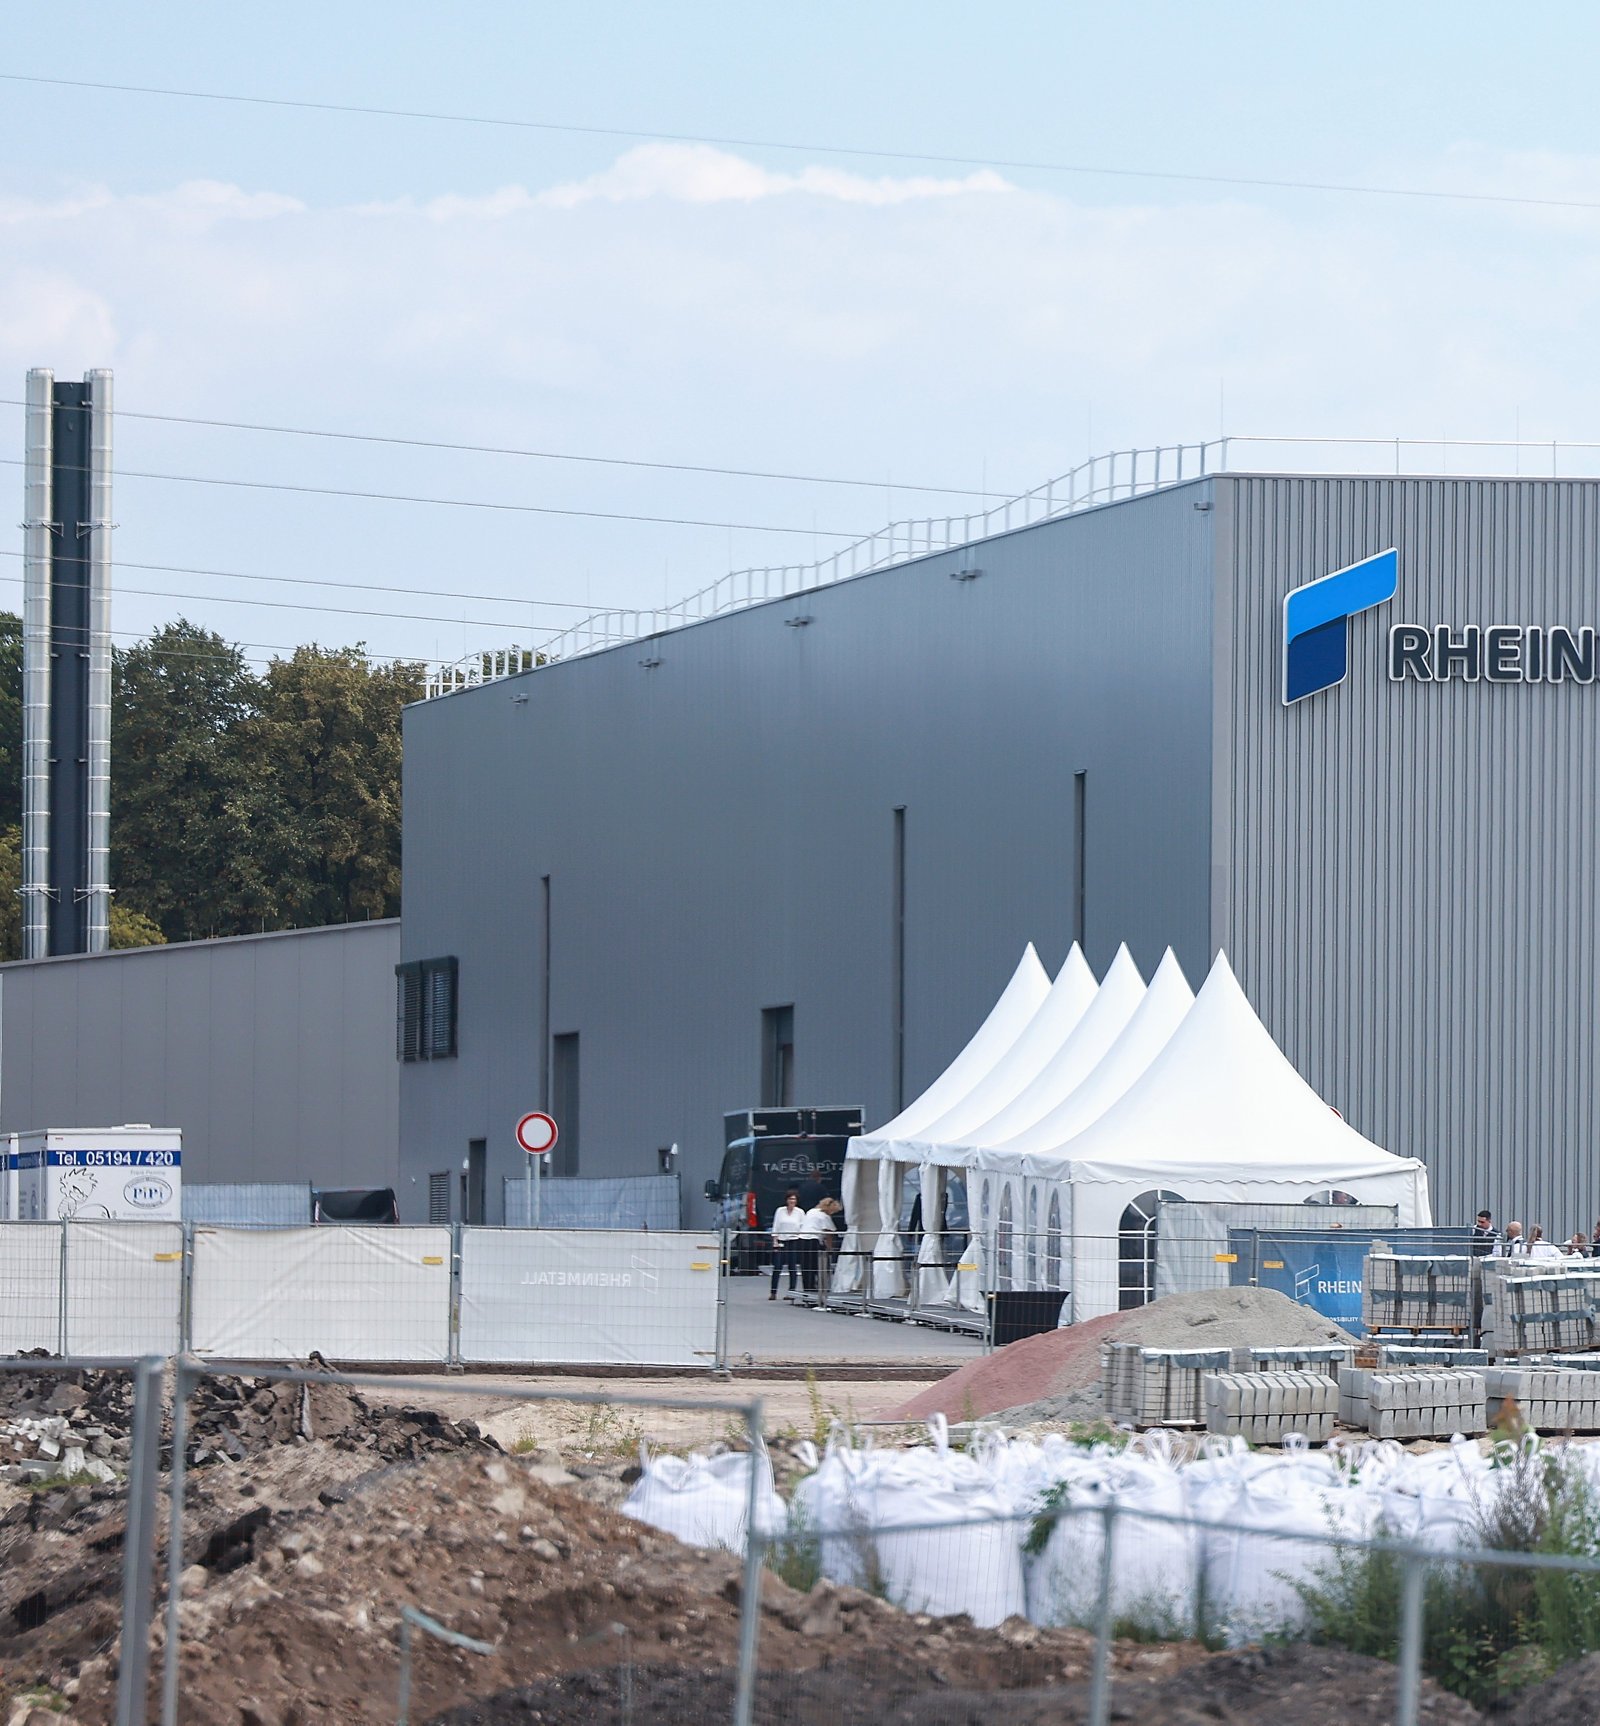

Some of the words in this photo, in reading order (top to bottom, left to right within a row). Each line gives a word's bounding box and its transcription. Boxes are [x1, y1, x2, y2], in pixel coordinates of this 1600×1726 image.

[55, 1151, 81, 1165] Tel.
[86, 1151, 132, 1166] 05194
[136, 1152, 142, 1166] /
[145, 1151, 174, 1166] 420
[1318, 1280, 1362, 1293] RHEIN
